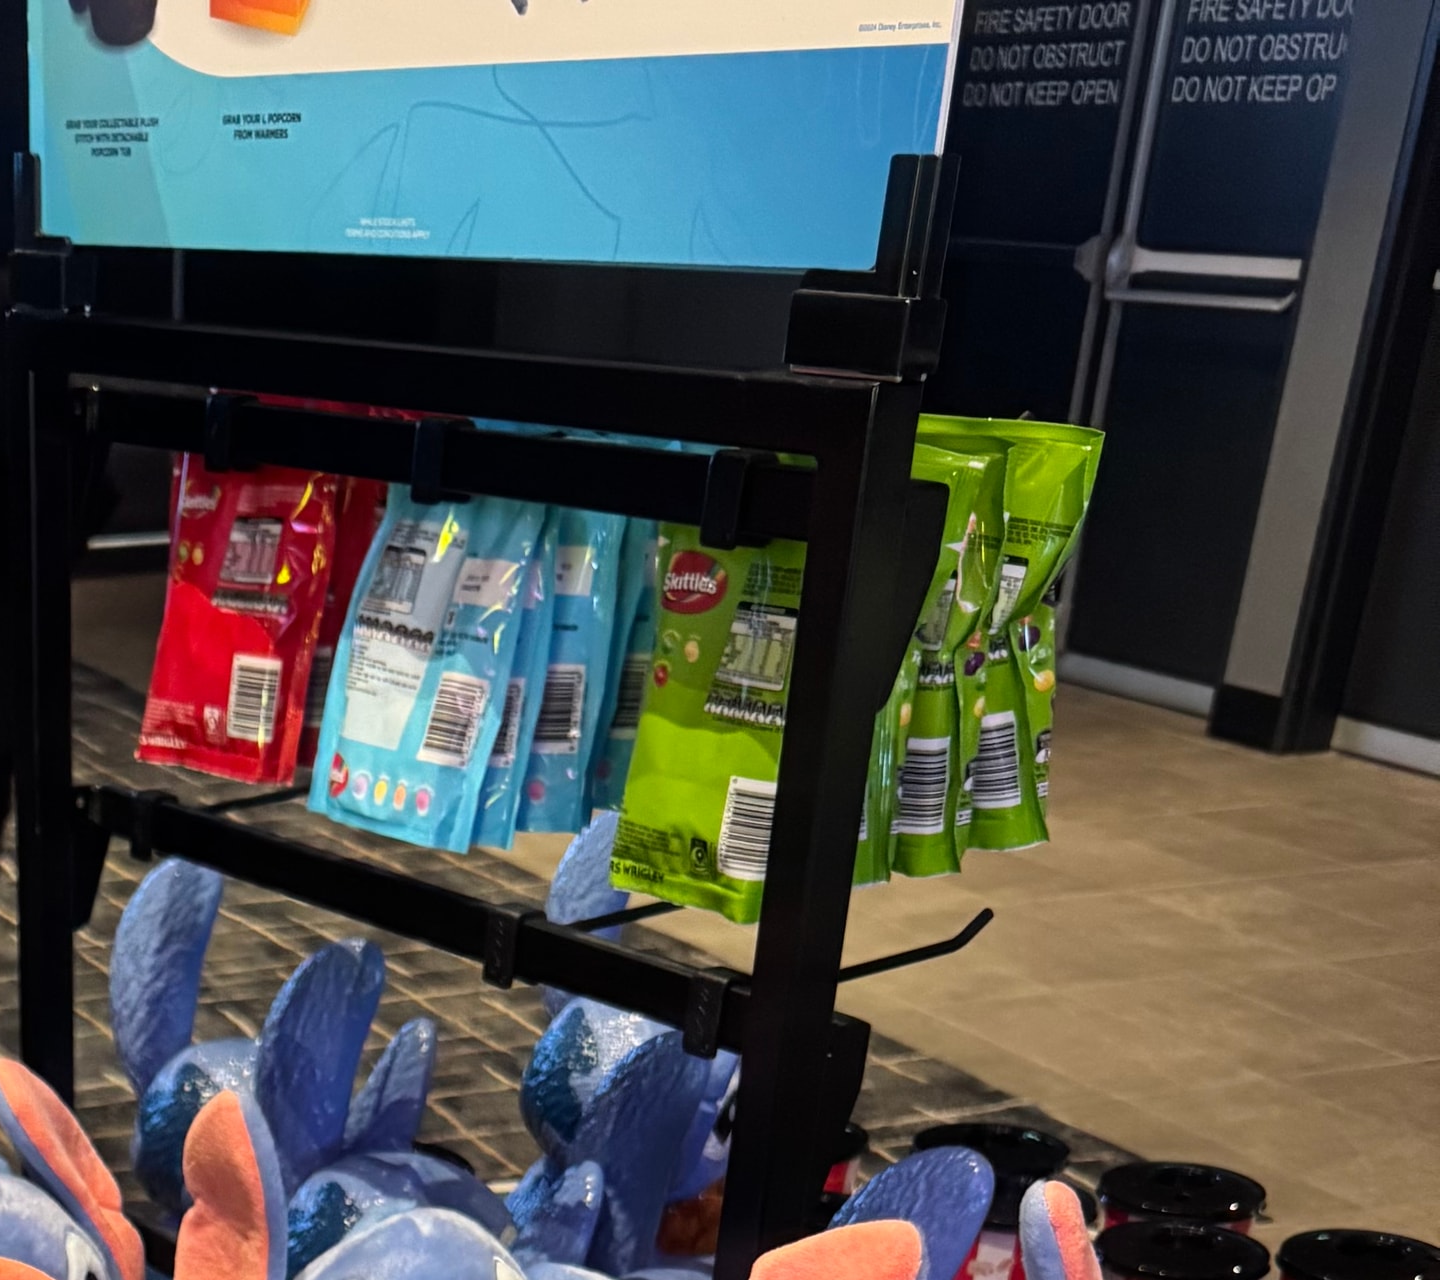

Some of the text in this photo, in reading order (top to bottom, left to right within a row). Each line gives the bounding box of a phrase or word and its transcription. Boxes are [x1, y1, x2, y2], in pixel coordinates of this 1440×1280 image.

[975, 2, 1130, 33] FIRE SAFETY DOOR
[1187, 0, 1233, 23] FIRE
[1235, 0, 1311, 21] SAFETY
[970, 40, 1126, 71] DO NOT OBSTRUCT
[1181, 36, 1211, 63] DO
[1214, 35, 1257, 63] NOT
[963, 79, 1120, 107] DO NOT KEEP OPEN
[1172, 76, 1200, 103] DO
[1204, 75, 1247, 102] NOT
[1248, 75, 1303, 102] KEEP
[663, 571, 718, 595] Skittles
